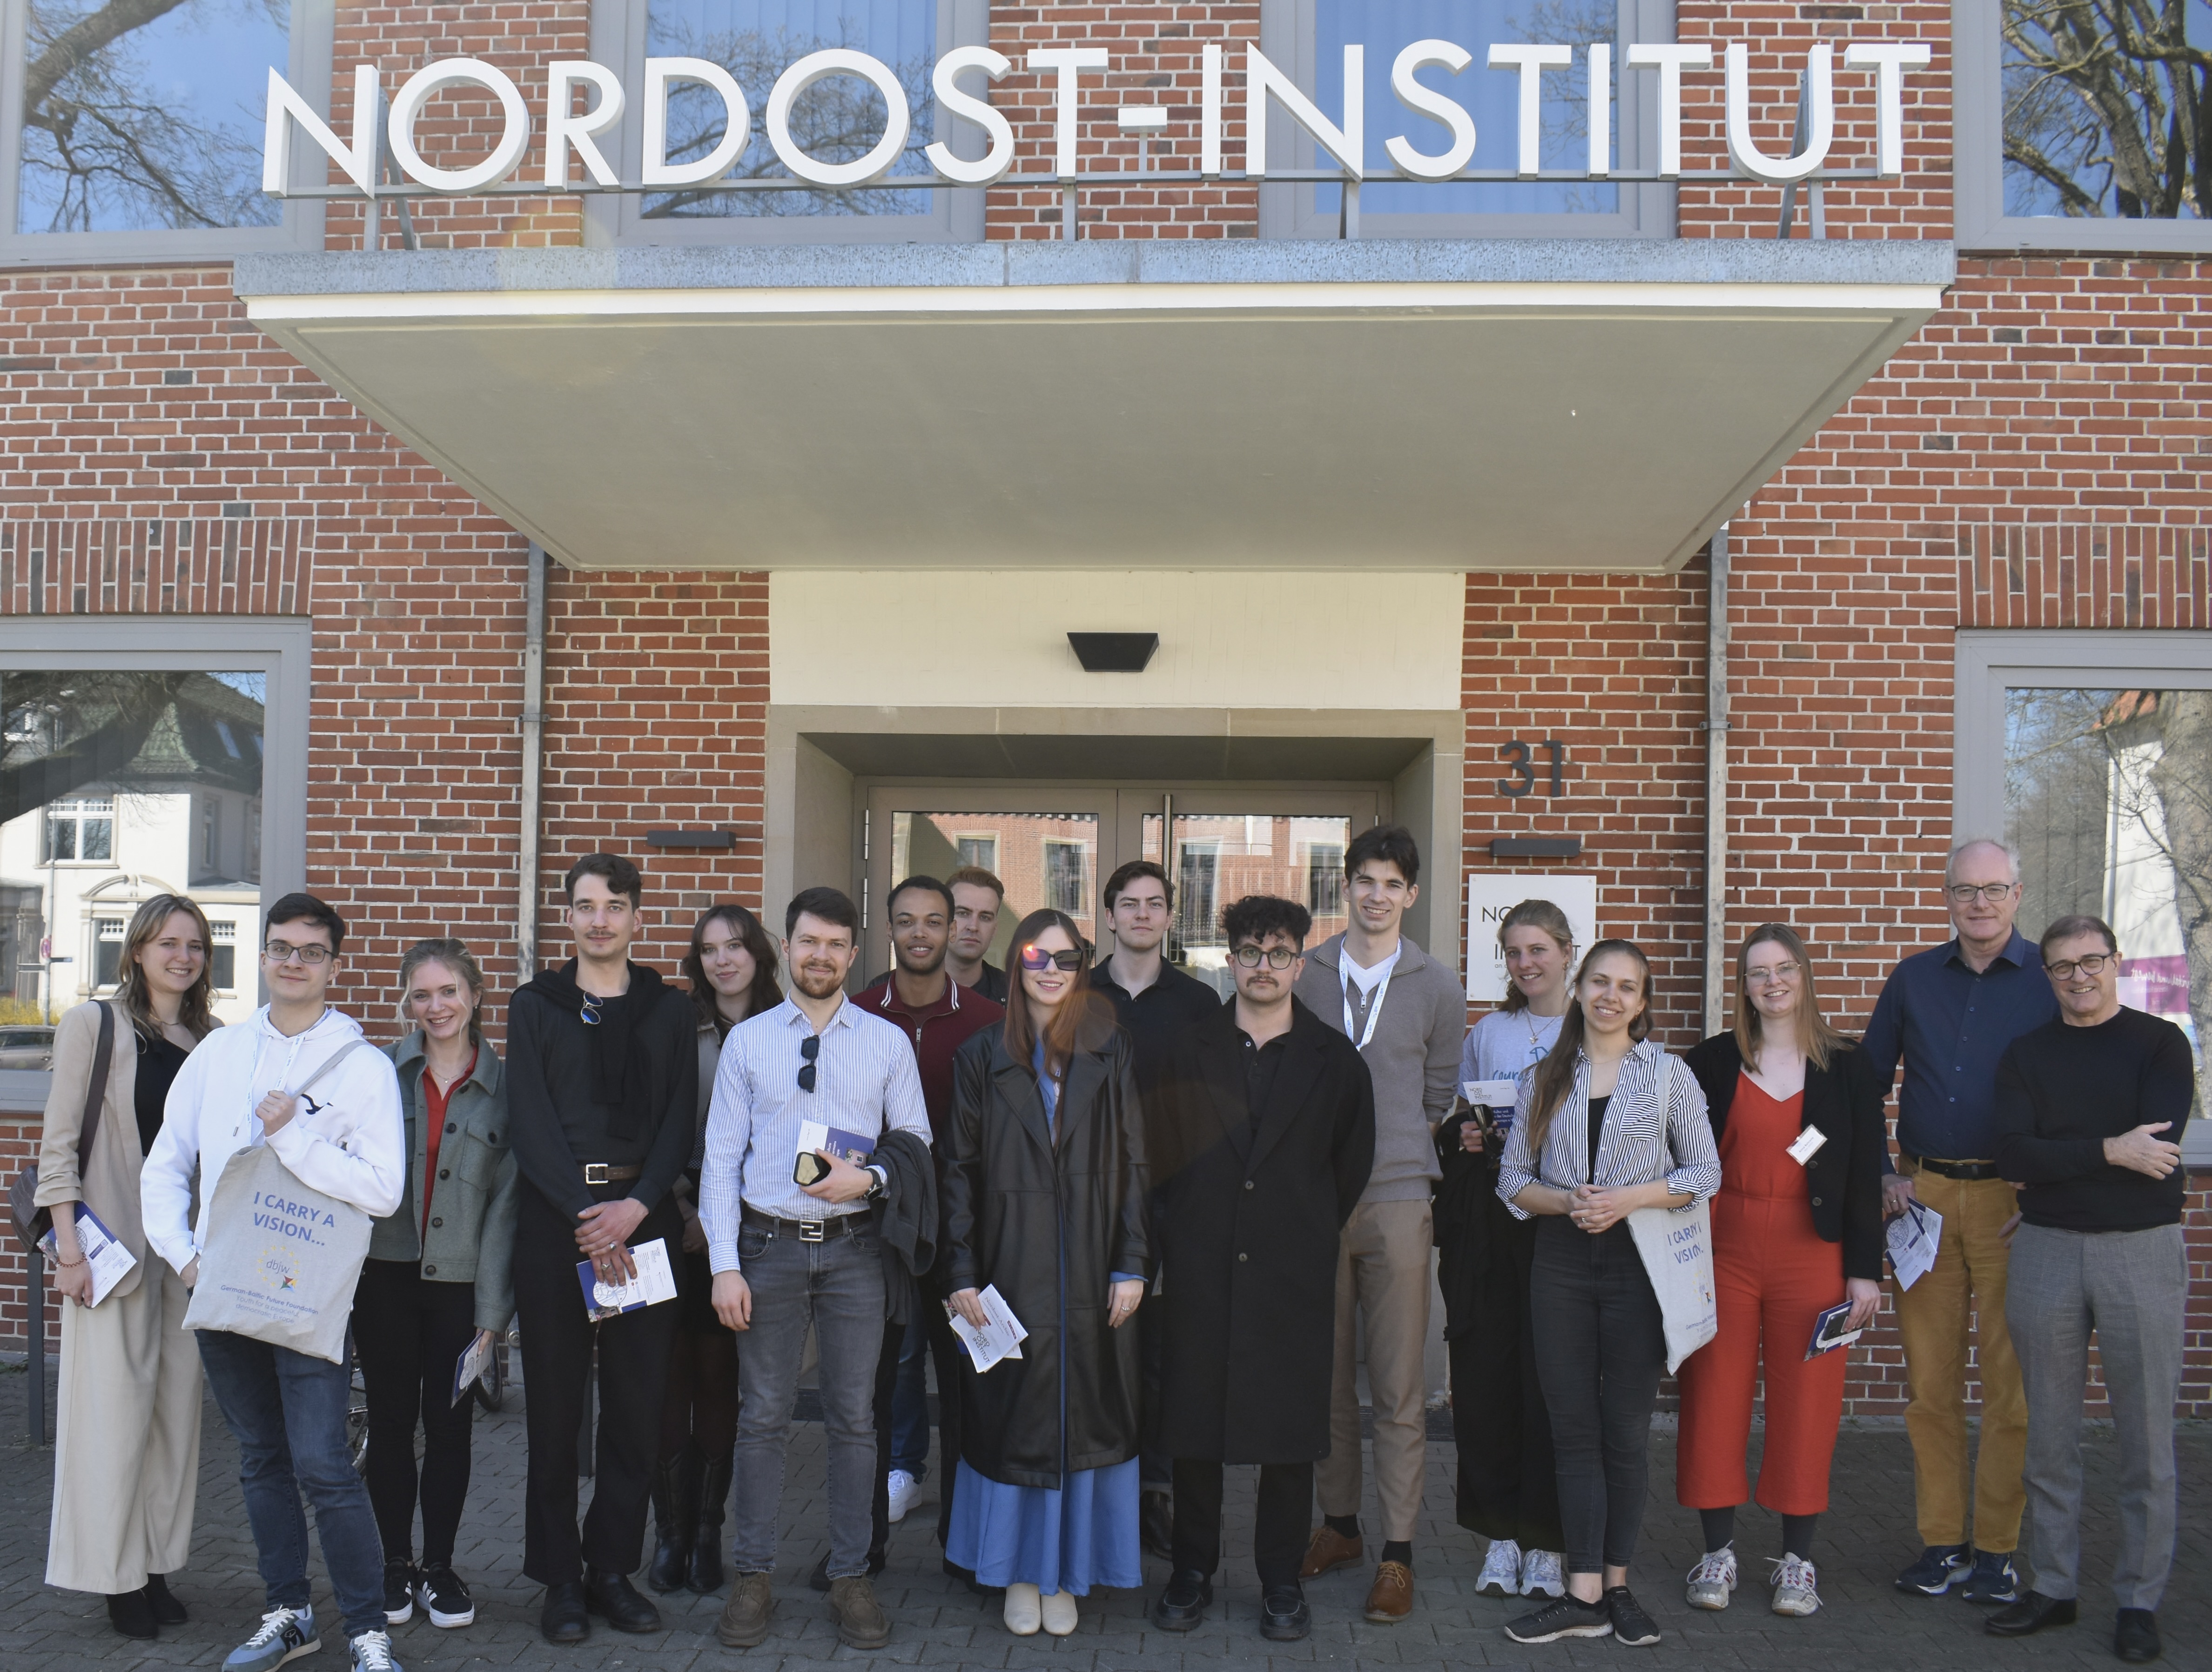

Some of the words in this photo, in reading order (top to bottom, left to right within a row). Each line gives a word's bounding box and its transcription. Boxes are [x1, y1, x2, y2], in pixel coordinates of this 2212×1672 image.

[262, 39, 1931, 198] NORDOST-INSTITUT
[1498, 740, 1562, 797] 31
[1482, 906, 1513, 922] NO
[1493, 1070, 1523, 1081] Coura
[254, 1192, 260, 1204] I
[265, 1194, 320, 1222] CARRY
[322, 1214, 335, 1228] A
[254, 1212, 325, 1246] VISION...
[266, 1259, 290, 1274] dbjw
[220, 1285, 265, 1300] German-Baltic
[266, 1296, 285, 1306] Future
[286, 1301, 319, 1315] Foundation
[236, 1295, 254, 1305] Youth
[235, 1303, 271, 1319] democratic
[972, 1337, 990, 1363] INSTITUT
[976, 1335, 987, 1348] OST
